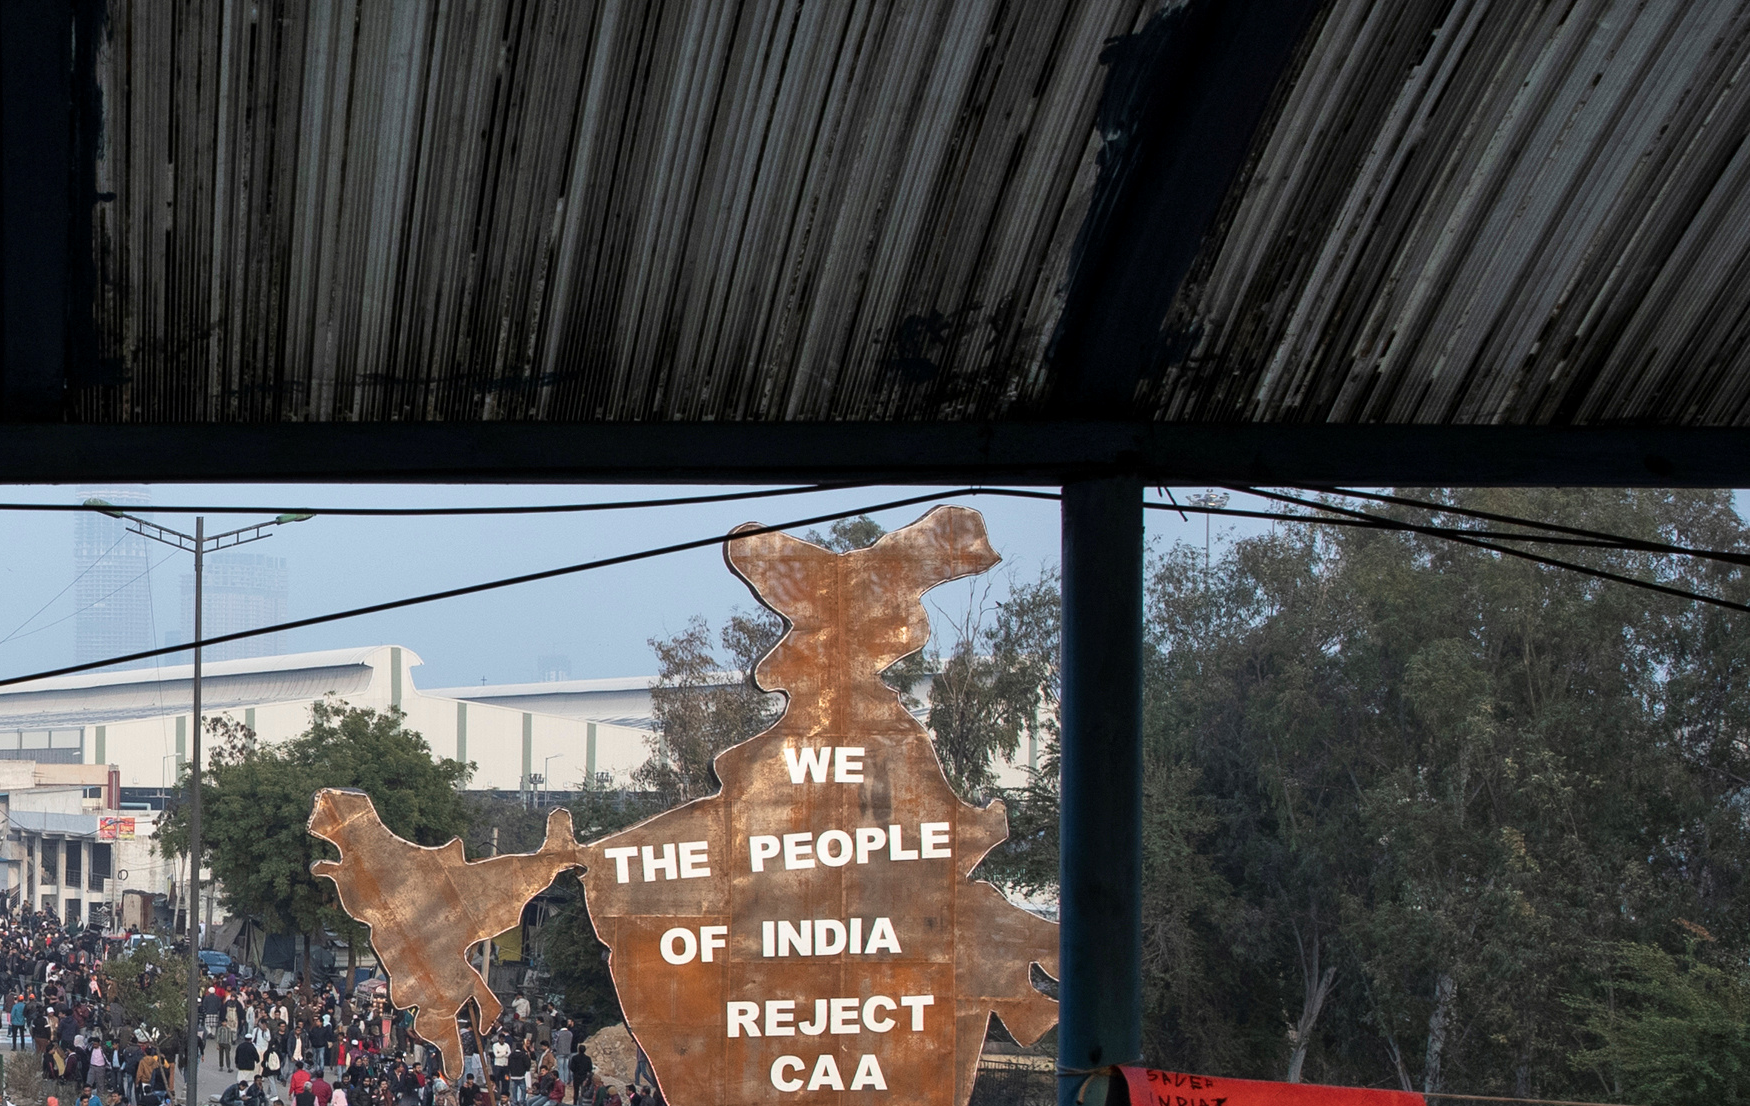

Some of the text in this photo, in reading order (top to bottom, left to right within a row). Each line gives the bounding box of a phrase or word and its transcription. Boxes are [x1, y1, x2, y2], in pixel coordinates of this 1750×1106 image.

[783, 747, 866, 784] WE
[604, 822, 952, 884] THE PEOPLE
[660, 917, 903, 965] OF INDIA
[726, 995, 935, 1038] REJECT
[770, 1054, 888, 1092] CAA
